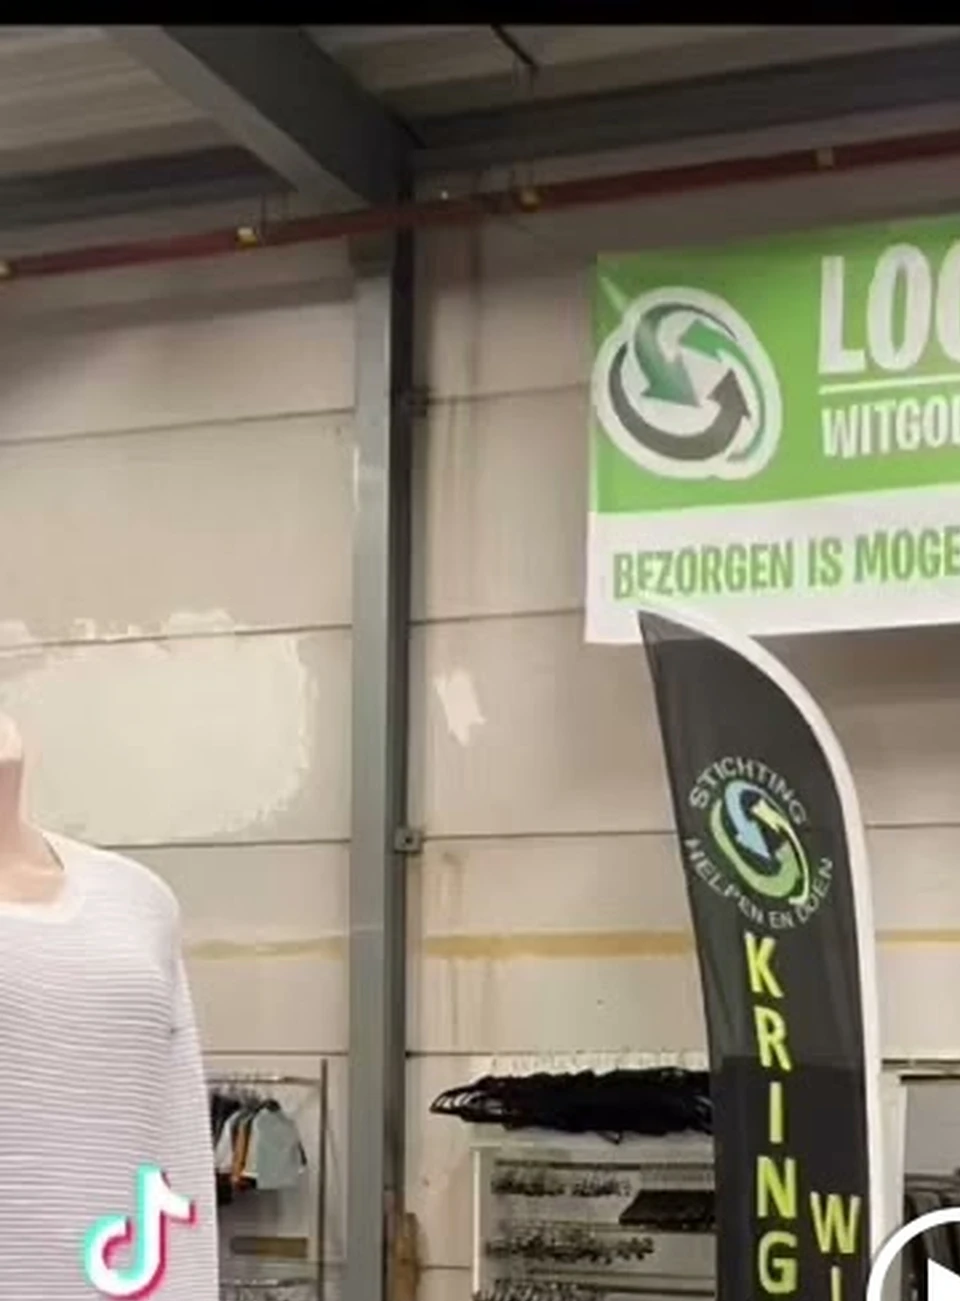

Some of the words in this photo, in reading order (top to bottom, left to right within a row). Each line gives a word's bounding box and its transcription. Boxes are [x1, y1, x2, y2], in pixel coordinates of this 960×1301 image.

[612, 538, 795, 601] BEZORGEN
[806, 532, 843, 587] IS
[688, 756, 808, 826] STICHTING
[768, 910, 795, 929] EN
